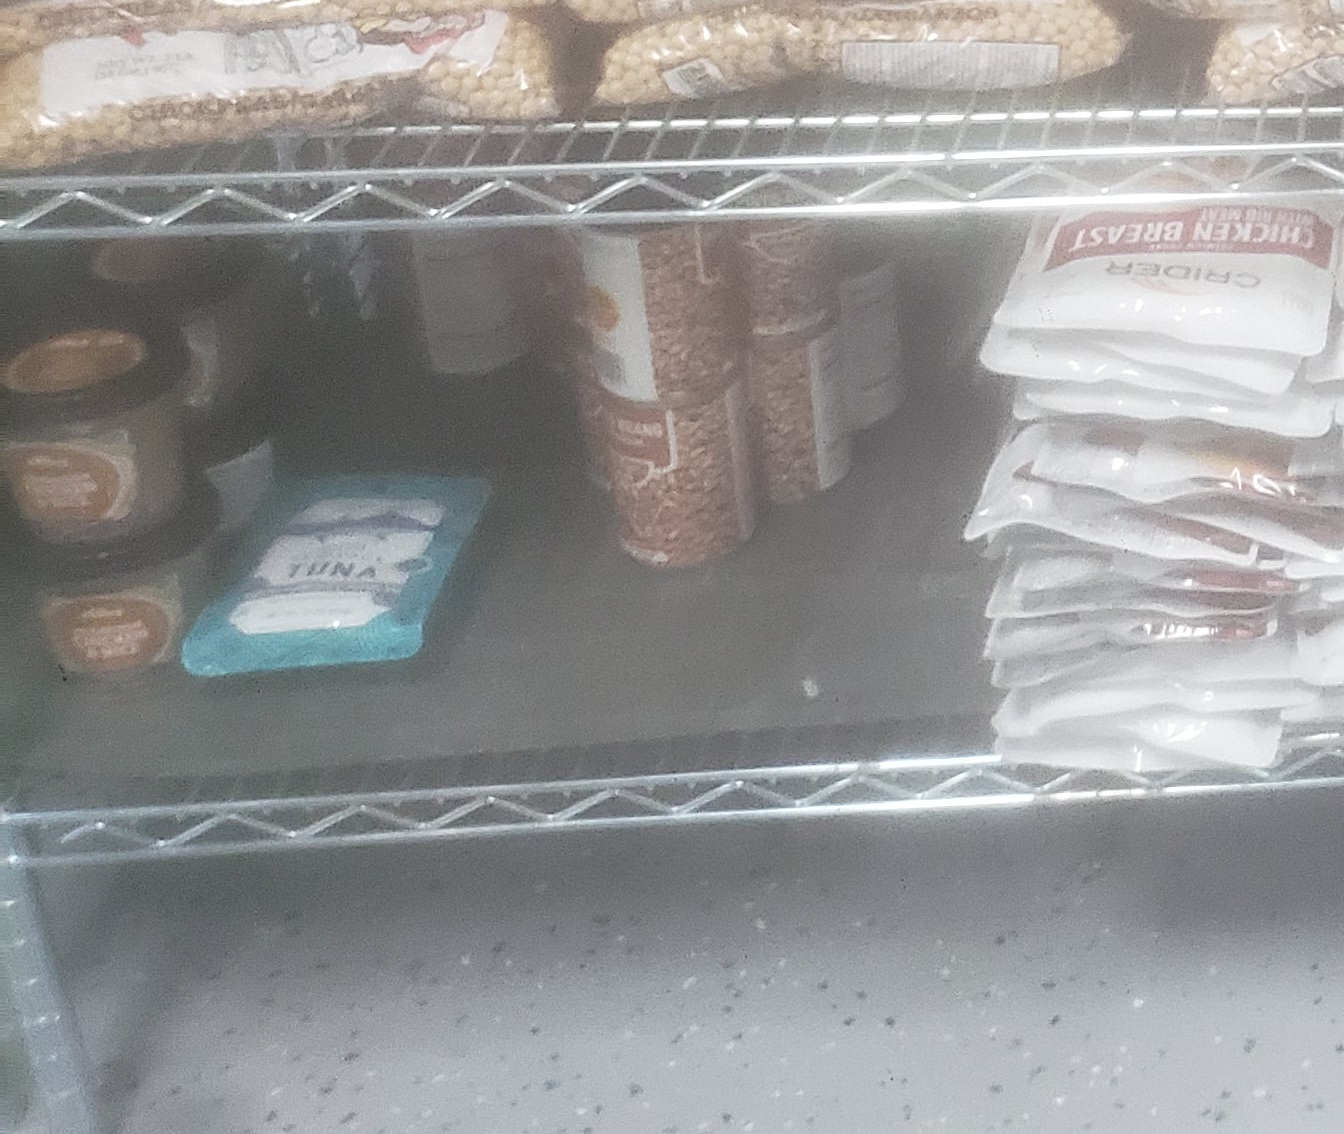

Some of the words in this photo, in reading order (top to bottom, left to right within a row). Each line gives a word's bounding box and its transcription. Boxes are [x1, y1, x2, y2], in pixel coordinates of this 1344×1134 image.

[1069, 220, 1182, 252] BREAST
[1193, 219, 1315, 248] CHICKEN
[1105, 259, 1262, 289] CRIDER
[287, 560, 376, 579] TUNA
